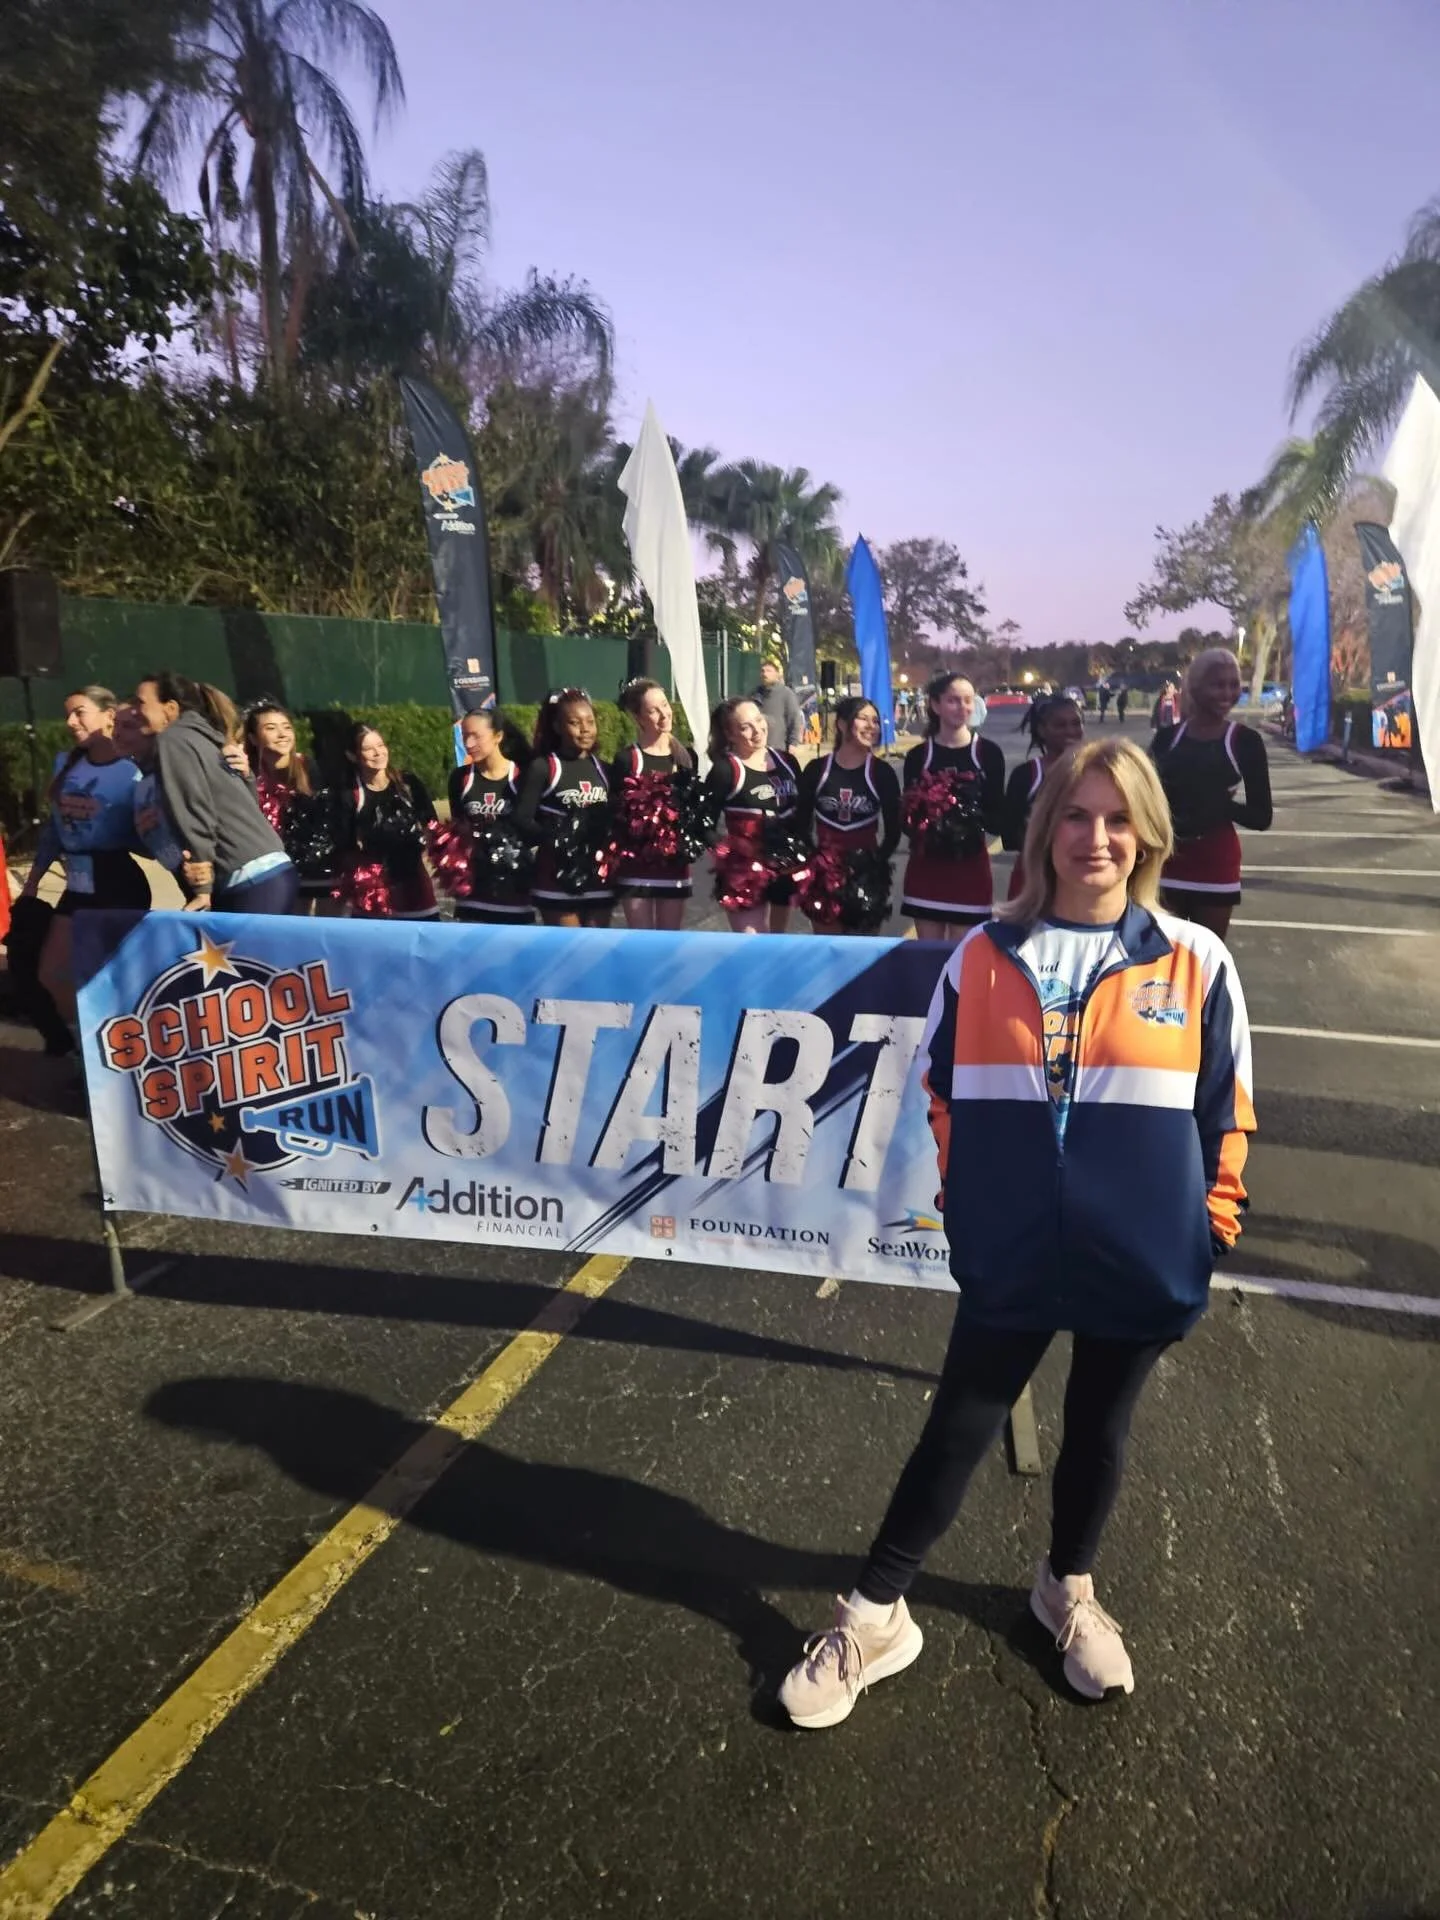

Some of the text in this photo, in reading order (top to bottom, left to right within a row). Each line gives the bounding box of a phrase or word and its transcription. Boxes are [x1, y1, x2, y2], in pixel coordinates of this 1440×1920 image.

[105, 961, 351, 1070] SCHOOL
[141, 1021, 345, 1121] SPIRIT
[421, 993, 927, 1192] START
[278, 1090, 367, 1144] RUN
[303, 1179, 382, 1194] IGNITED BY
[395, 1176, 564, 1223] Addition
[475, 1221, 562, 1239] FINANCIAL
[690, 1218, 830, 1246] FOUNDATION
